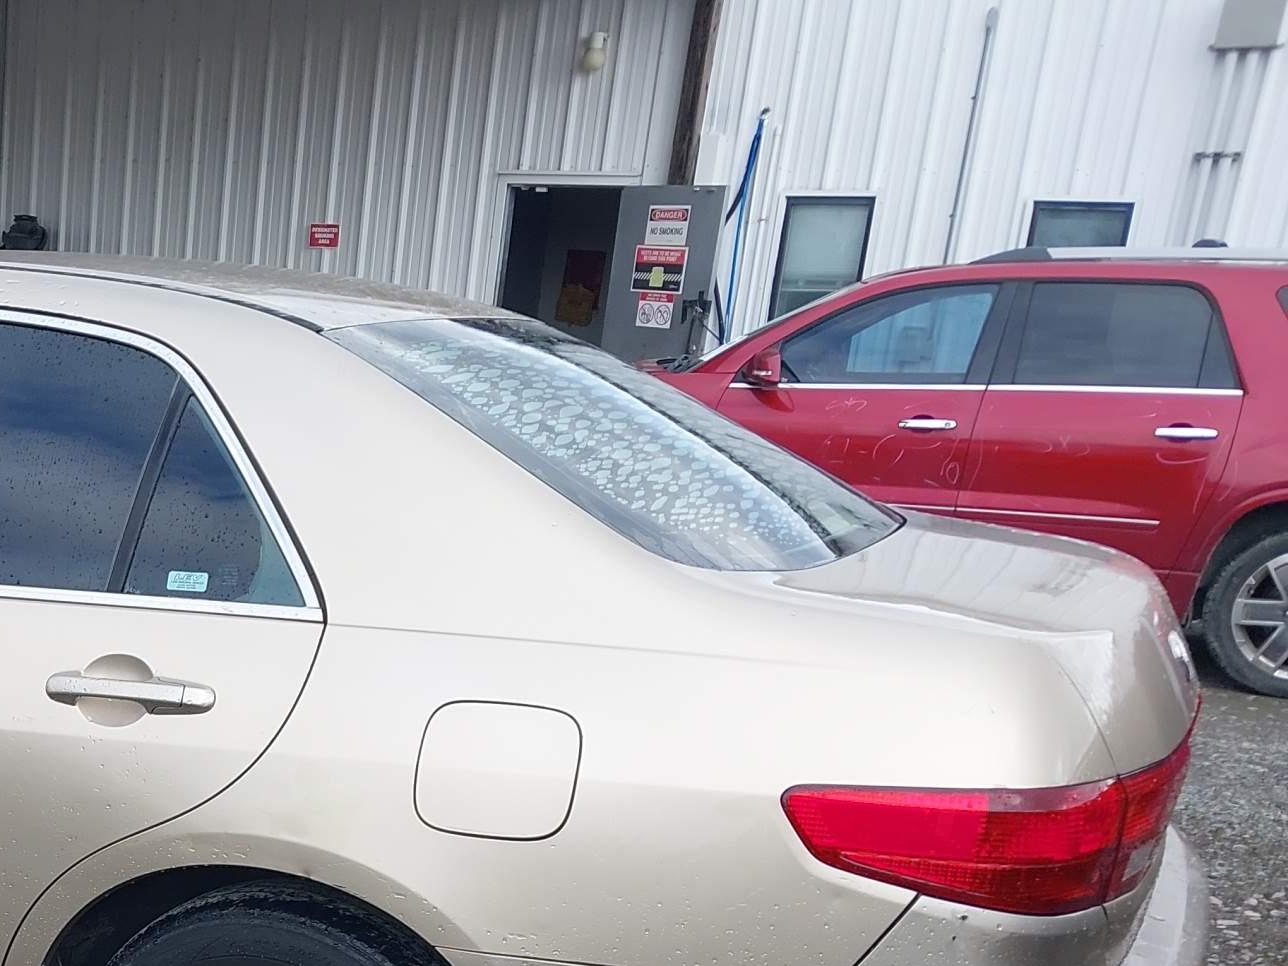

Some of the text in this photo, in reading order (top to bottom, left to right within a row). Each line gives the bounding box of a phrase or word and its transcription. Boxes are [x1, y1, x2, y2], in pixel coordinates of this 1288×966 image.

[655, 211, 683, 220] DANGER
[650, 227, 683, 236] NO SMOKING
